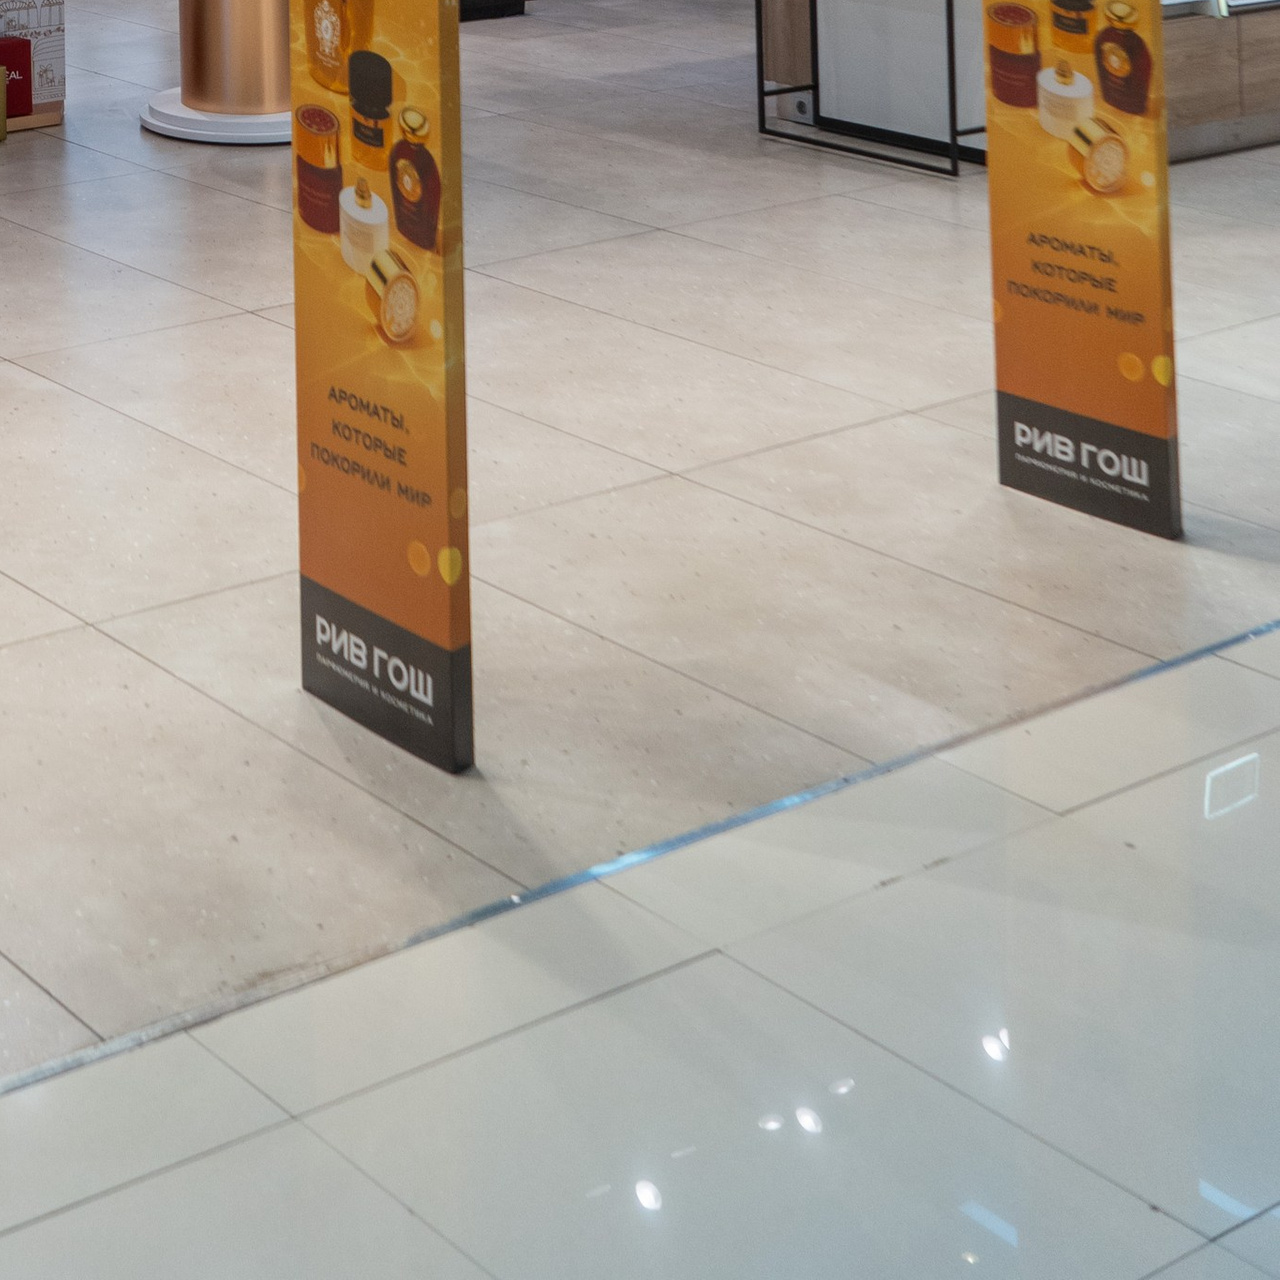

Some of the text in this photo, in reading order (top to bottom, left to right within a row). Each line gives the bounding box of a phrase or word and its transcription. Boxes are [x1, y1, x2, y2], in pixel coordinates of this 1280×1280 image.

[1006, 279, 1146, 325] ПОКОРИЛИ МИР
[1031, 259, 1118, 293] КОТОРЫЕ
[332, 419, 407, 467] КОТОРЫЕ
[1014, 420, 1149, 488] РИВ ГОШ
[310, 442, 432, 508] ПОКОРИЛИ МИР
[315, 613, 434, 709] РИВ ГОШ
